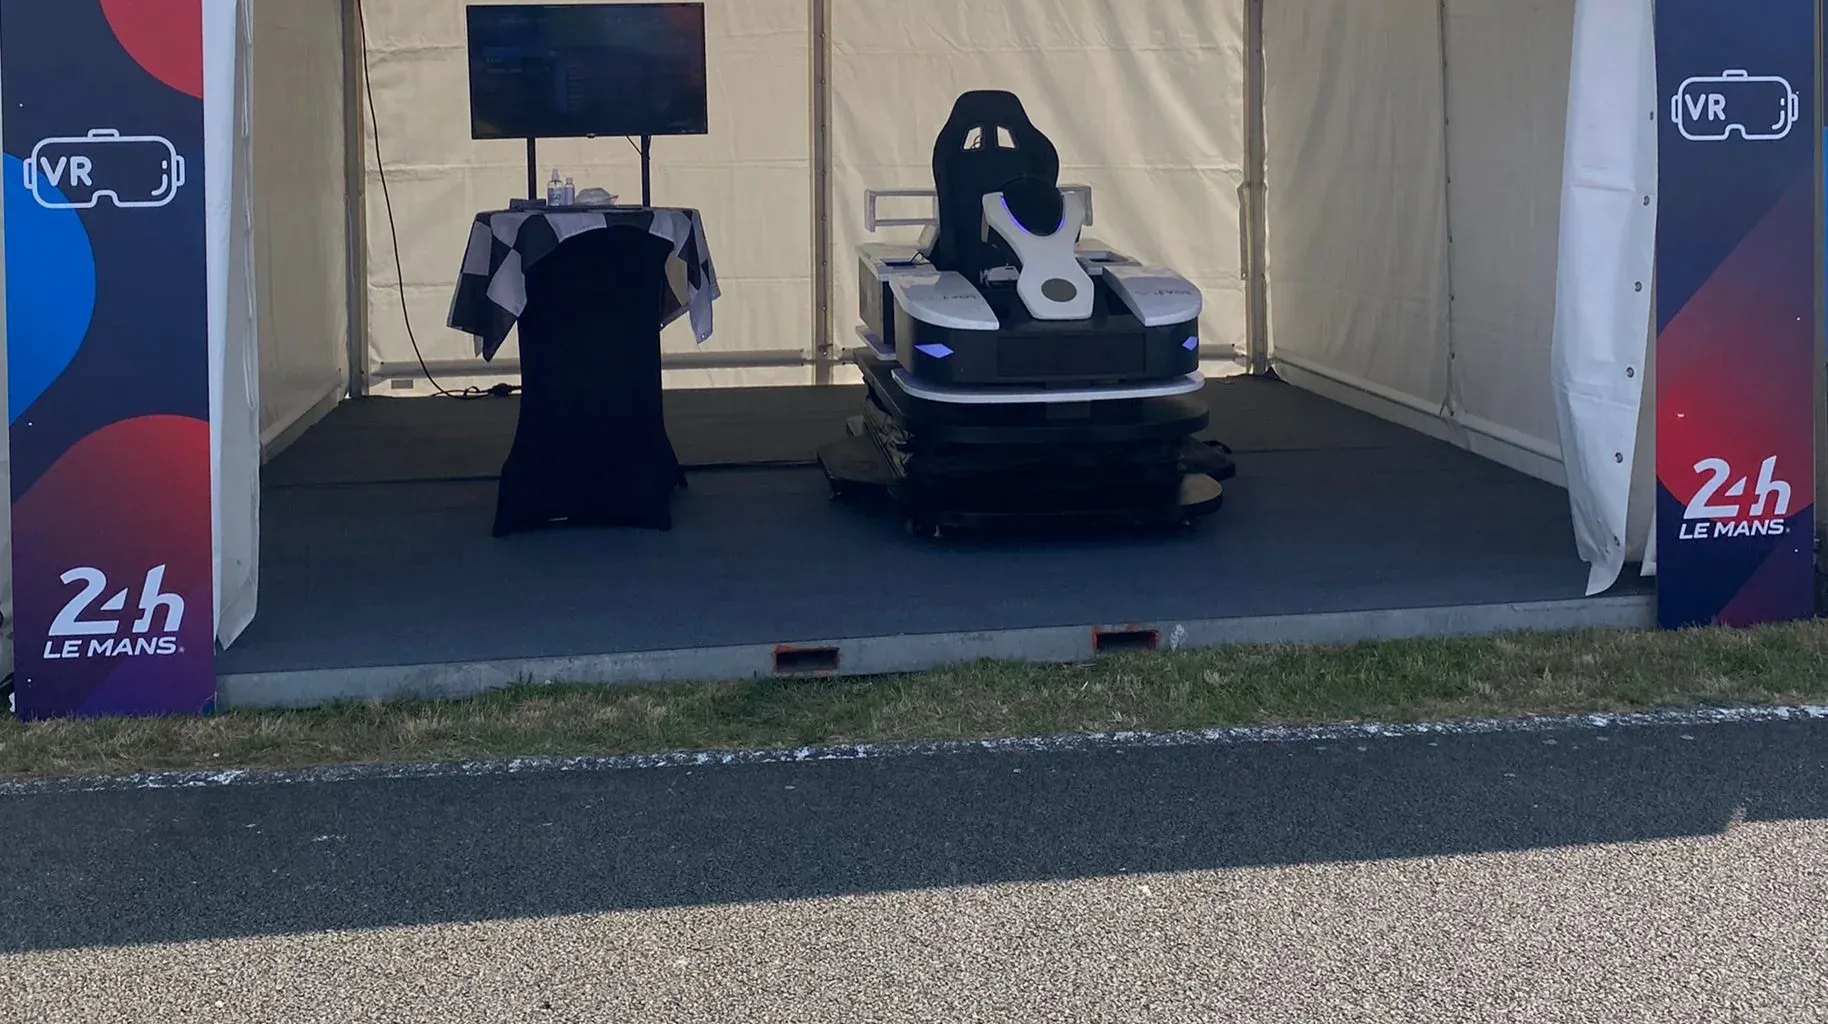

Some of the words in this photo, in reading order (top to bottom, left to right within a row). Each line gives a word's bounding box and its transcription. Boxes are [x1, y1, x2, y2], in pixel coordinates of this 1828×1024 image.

[1684, 93, 1726, 121] VR
[40, 156, 93, 187] VR
[1683, 455, 1792, 519] 24h
[1679, 523, 1710, 540] LE
[1713, 519, 1785, 538] MANS
[48, 564, 185, 636] 24h
[43, 640, 82, 659] LE
[87, 636, 177, 657] MANS
